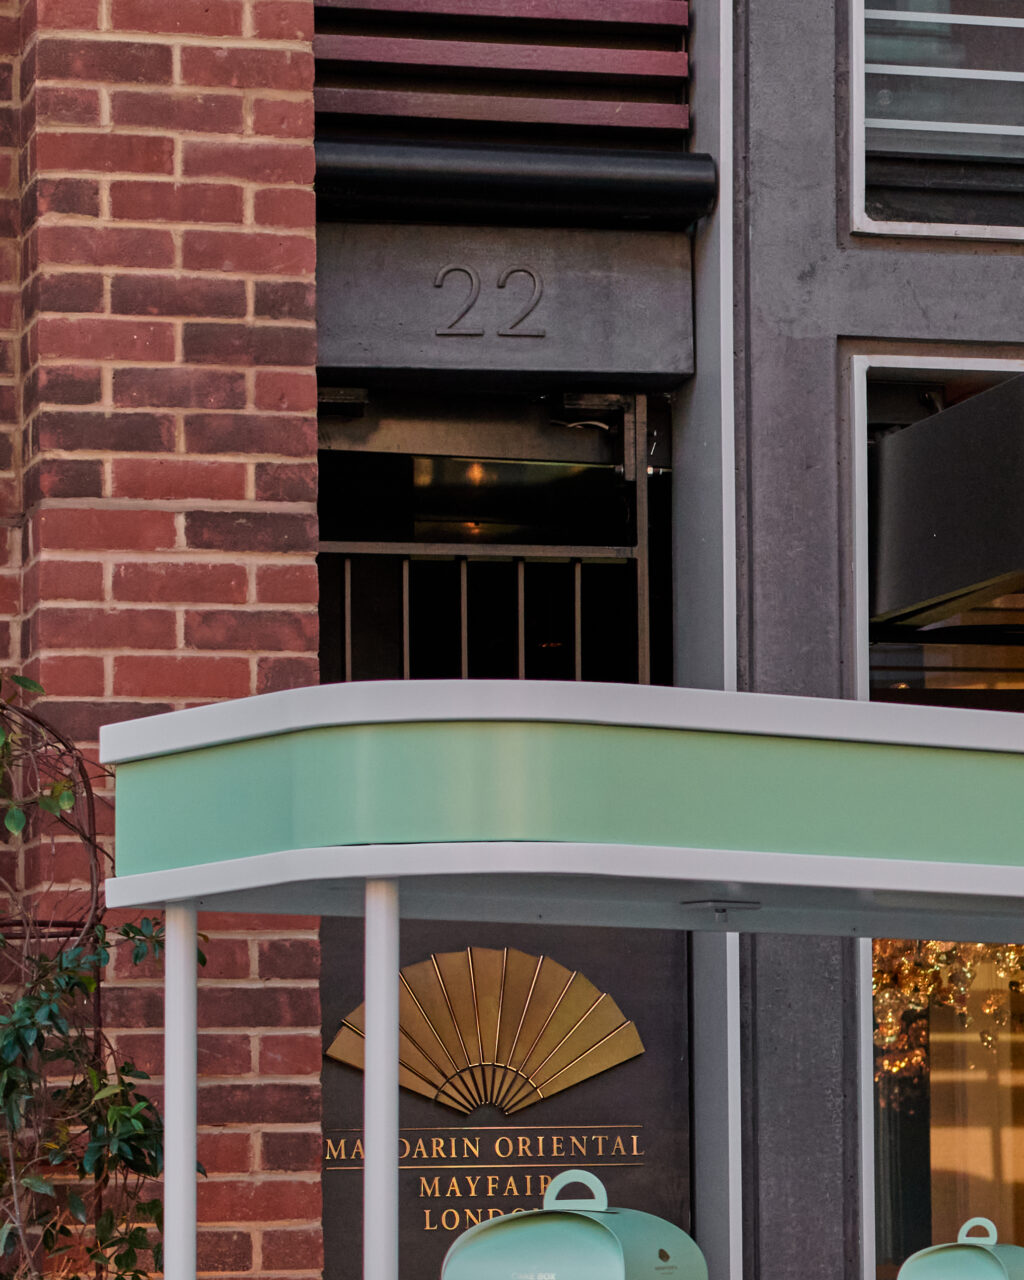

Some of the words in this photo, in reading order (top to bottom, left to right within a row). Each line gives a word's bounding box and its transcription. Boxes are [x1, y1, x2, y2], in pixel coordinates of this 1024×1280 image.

[432, 262, 547, 338] 22
[325, 1137, 480, 1160] MADARIN
[494, 1135, 646, 1158] ORIENTAL
